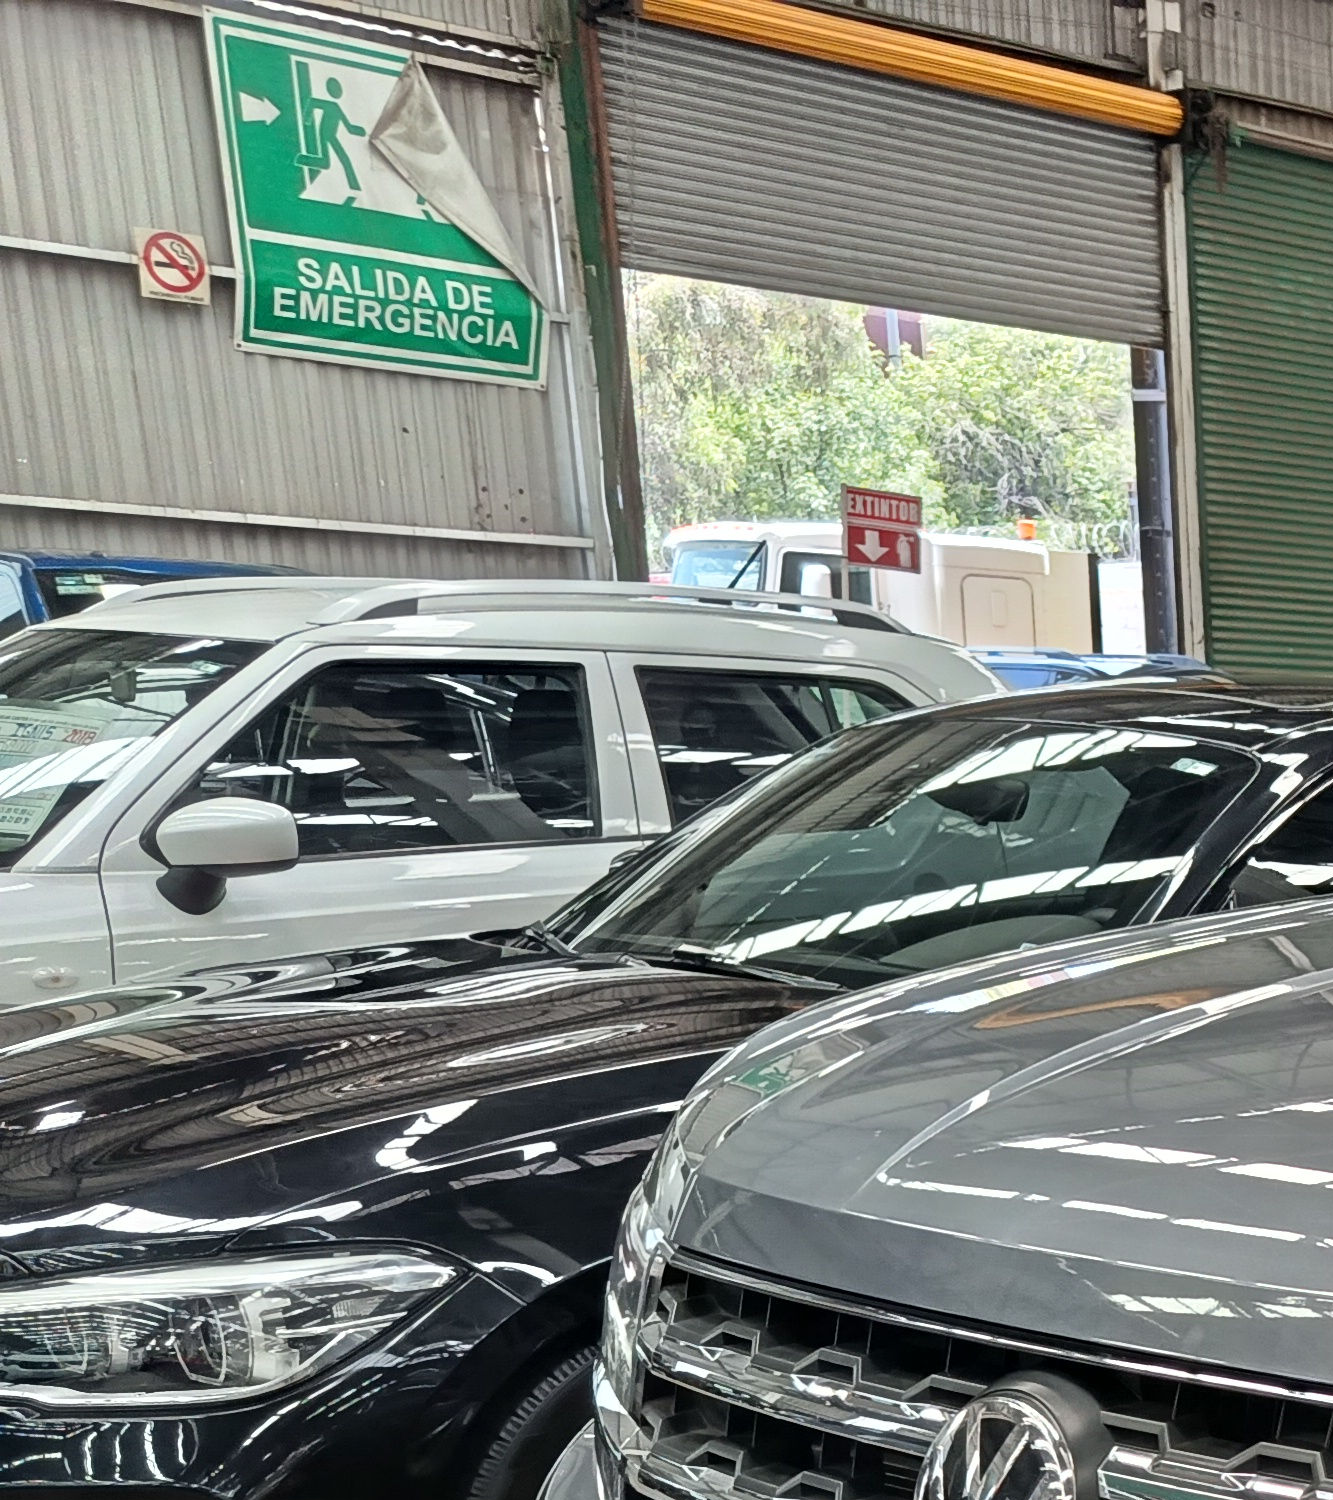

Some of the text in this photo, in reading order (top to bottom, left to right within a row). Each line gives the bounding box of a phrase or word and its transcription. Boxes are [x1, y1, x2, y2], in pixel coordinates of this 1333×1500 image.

[297, 257, 495, 316] SALIDA DE
[272, 286, 520, 350] EMERGENCIA
[847, 493, 919, 522] EXTINTOR
